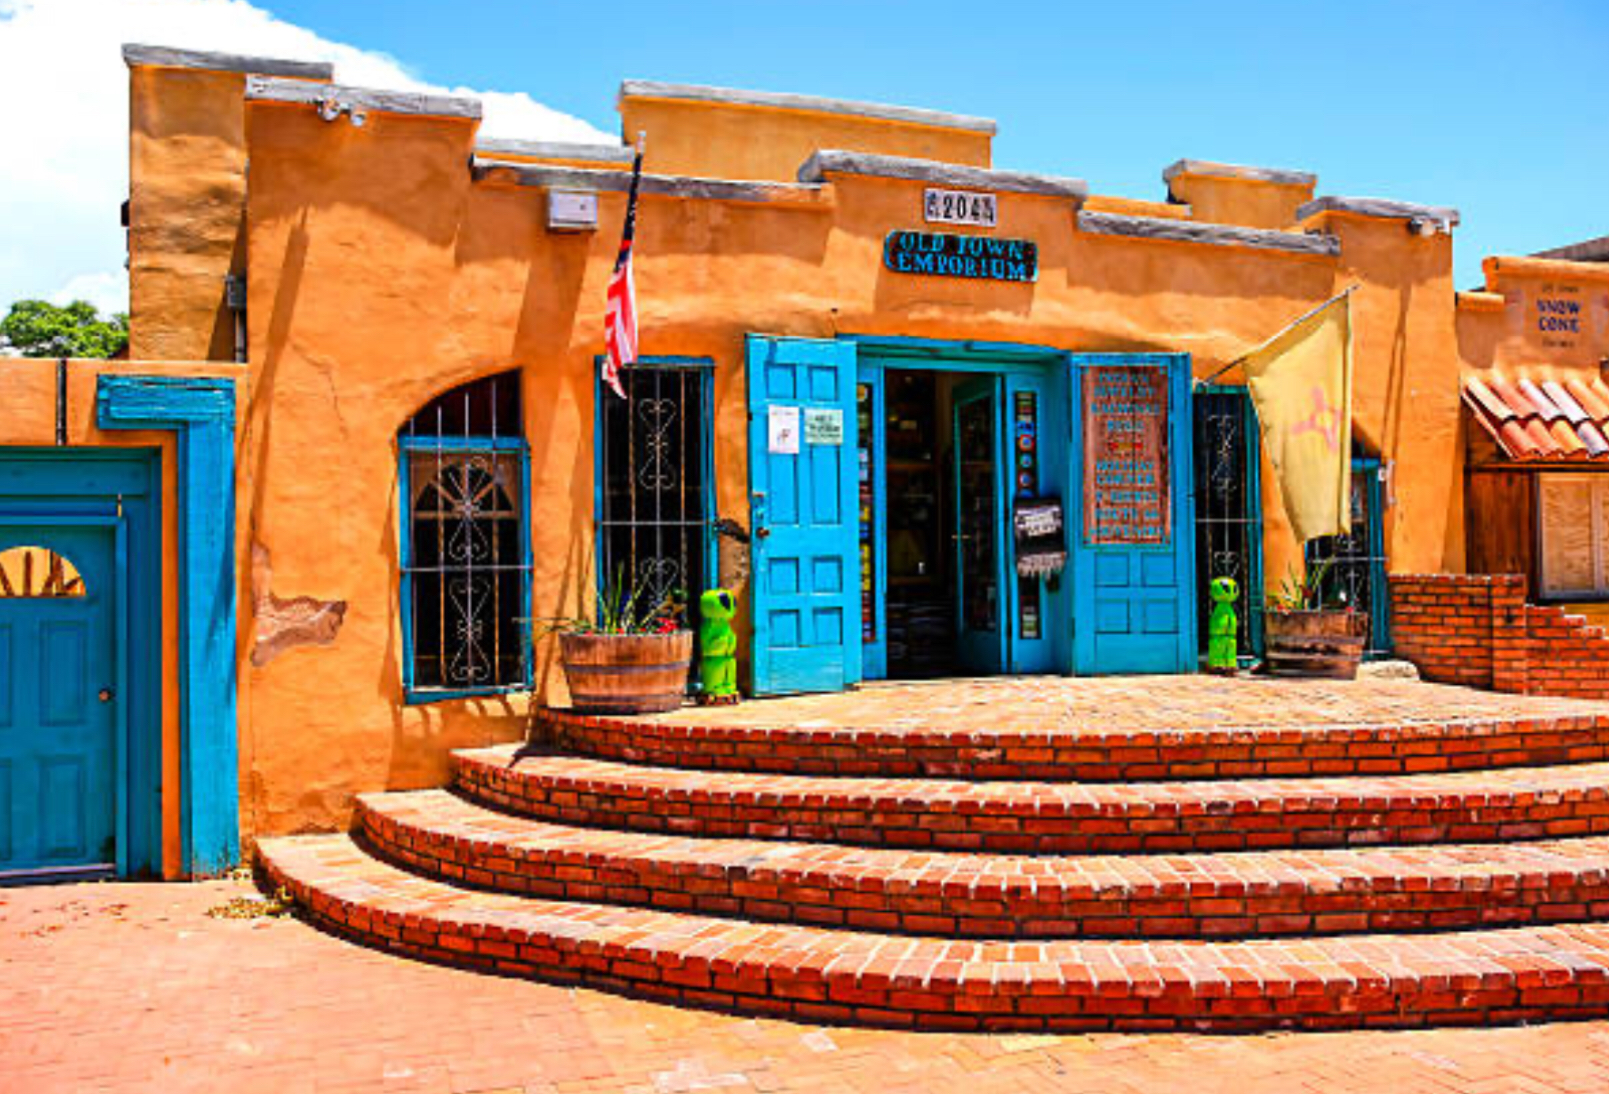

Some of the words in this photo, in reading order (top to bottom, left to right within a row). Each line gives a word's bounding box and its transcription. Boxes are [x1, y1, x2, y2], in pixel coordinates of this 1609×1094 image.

[899, 232, 945, 252] OLD
[957, 234, 1024, 260] TOWN
[897, 252, 1026, 281] EMPORIUM
